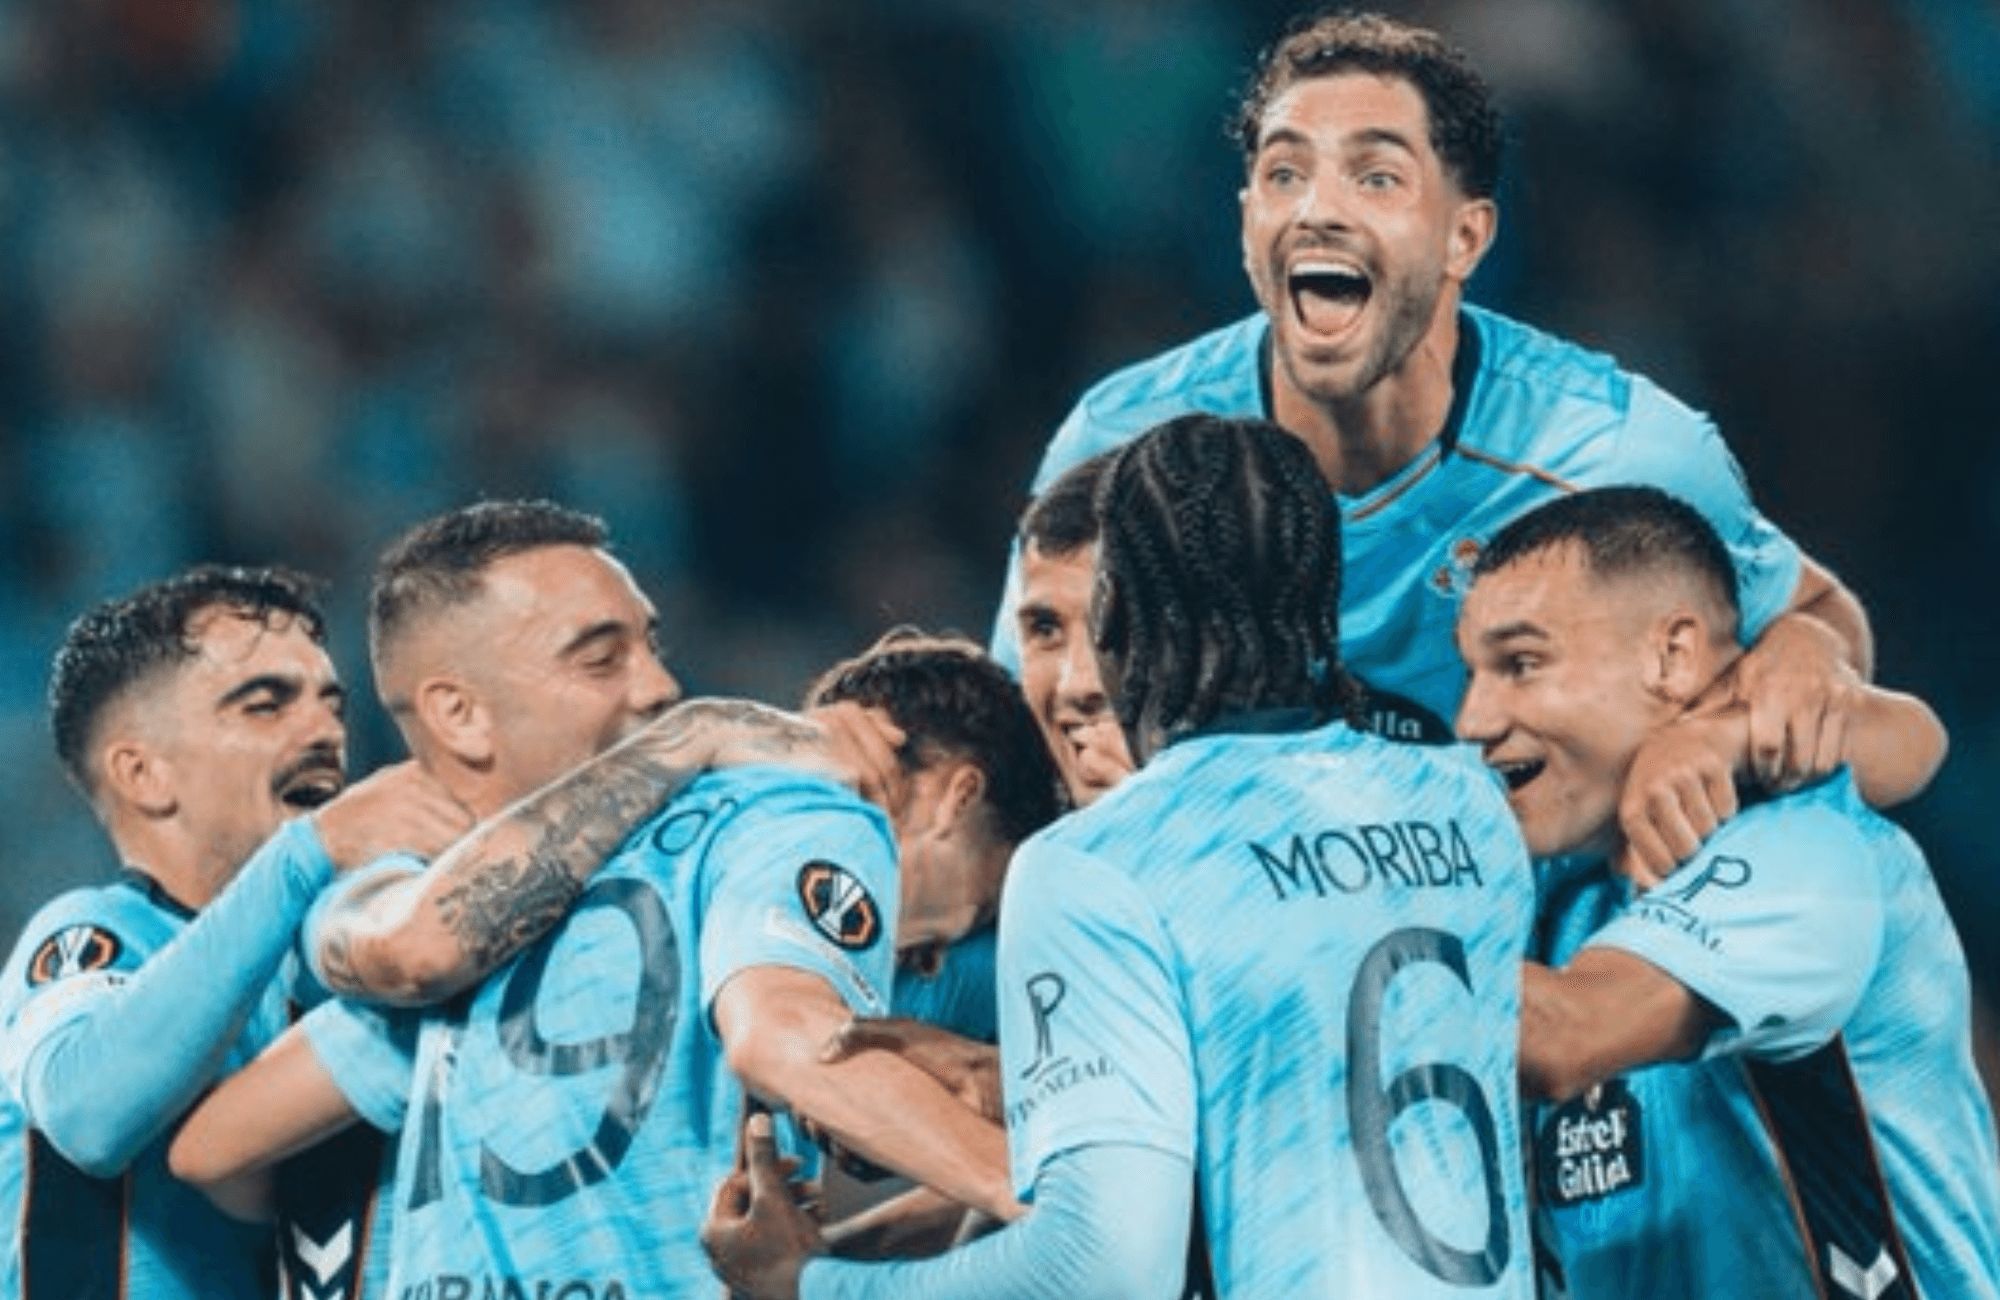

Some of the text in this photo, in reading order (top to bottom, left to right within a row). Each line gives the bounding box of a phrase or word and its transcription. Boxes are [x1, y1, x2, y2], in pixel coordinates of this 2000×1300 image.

[1373, 710, 1422, 739] lla
[1247, 816, 1484, 901] MORIBA
[1345, 926, 1509, 1288] 6
